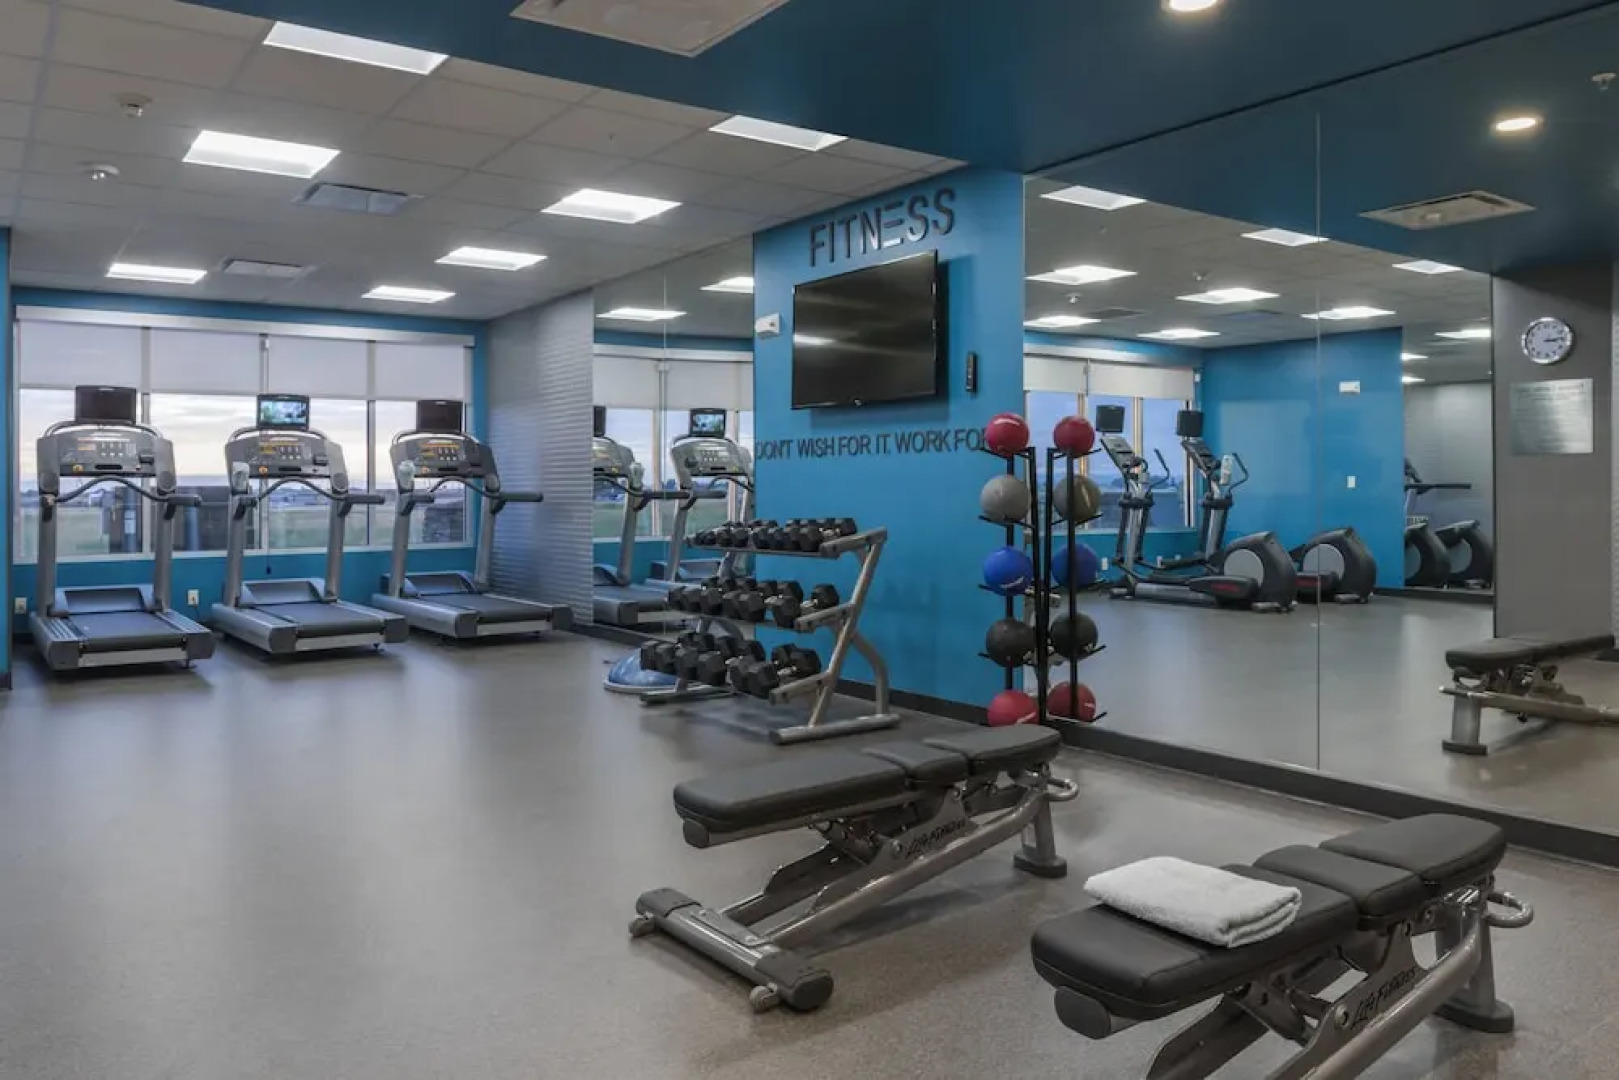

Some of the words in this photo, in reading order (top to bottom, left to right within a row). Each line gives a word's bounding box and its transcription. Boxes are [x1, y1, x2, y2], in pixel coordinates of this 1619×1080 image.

[810, 187, 955, 267] FITNESS
[798, 436, 835, 458] WISH
[838, 434, 871, 456] FOR
[895, 430, 952, 453] WORK
